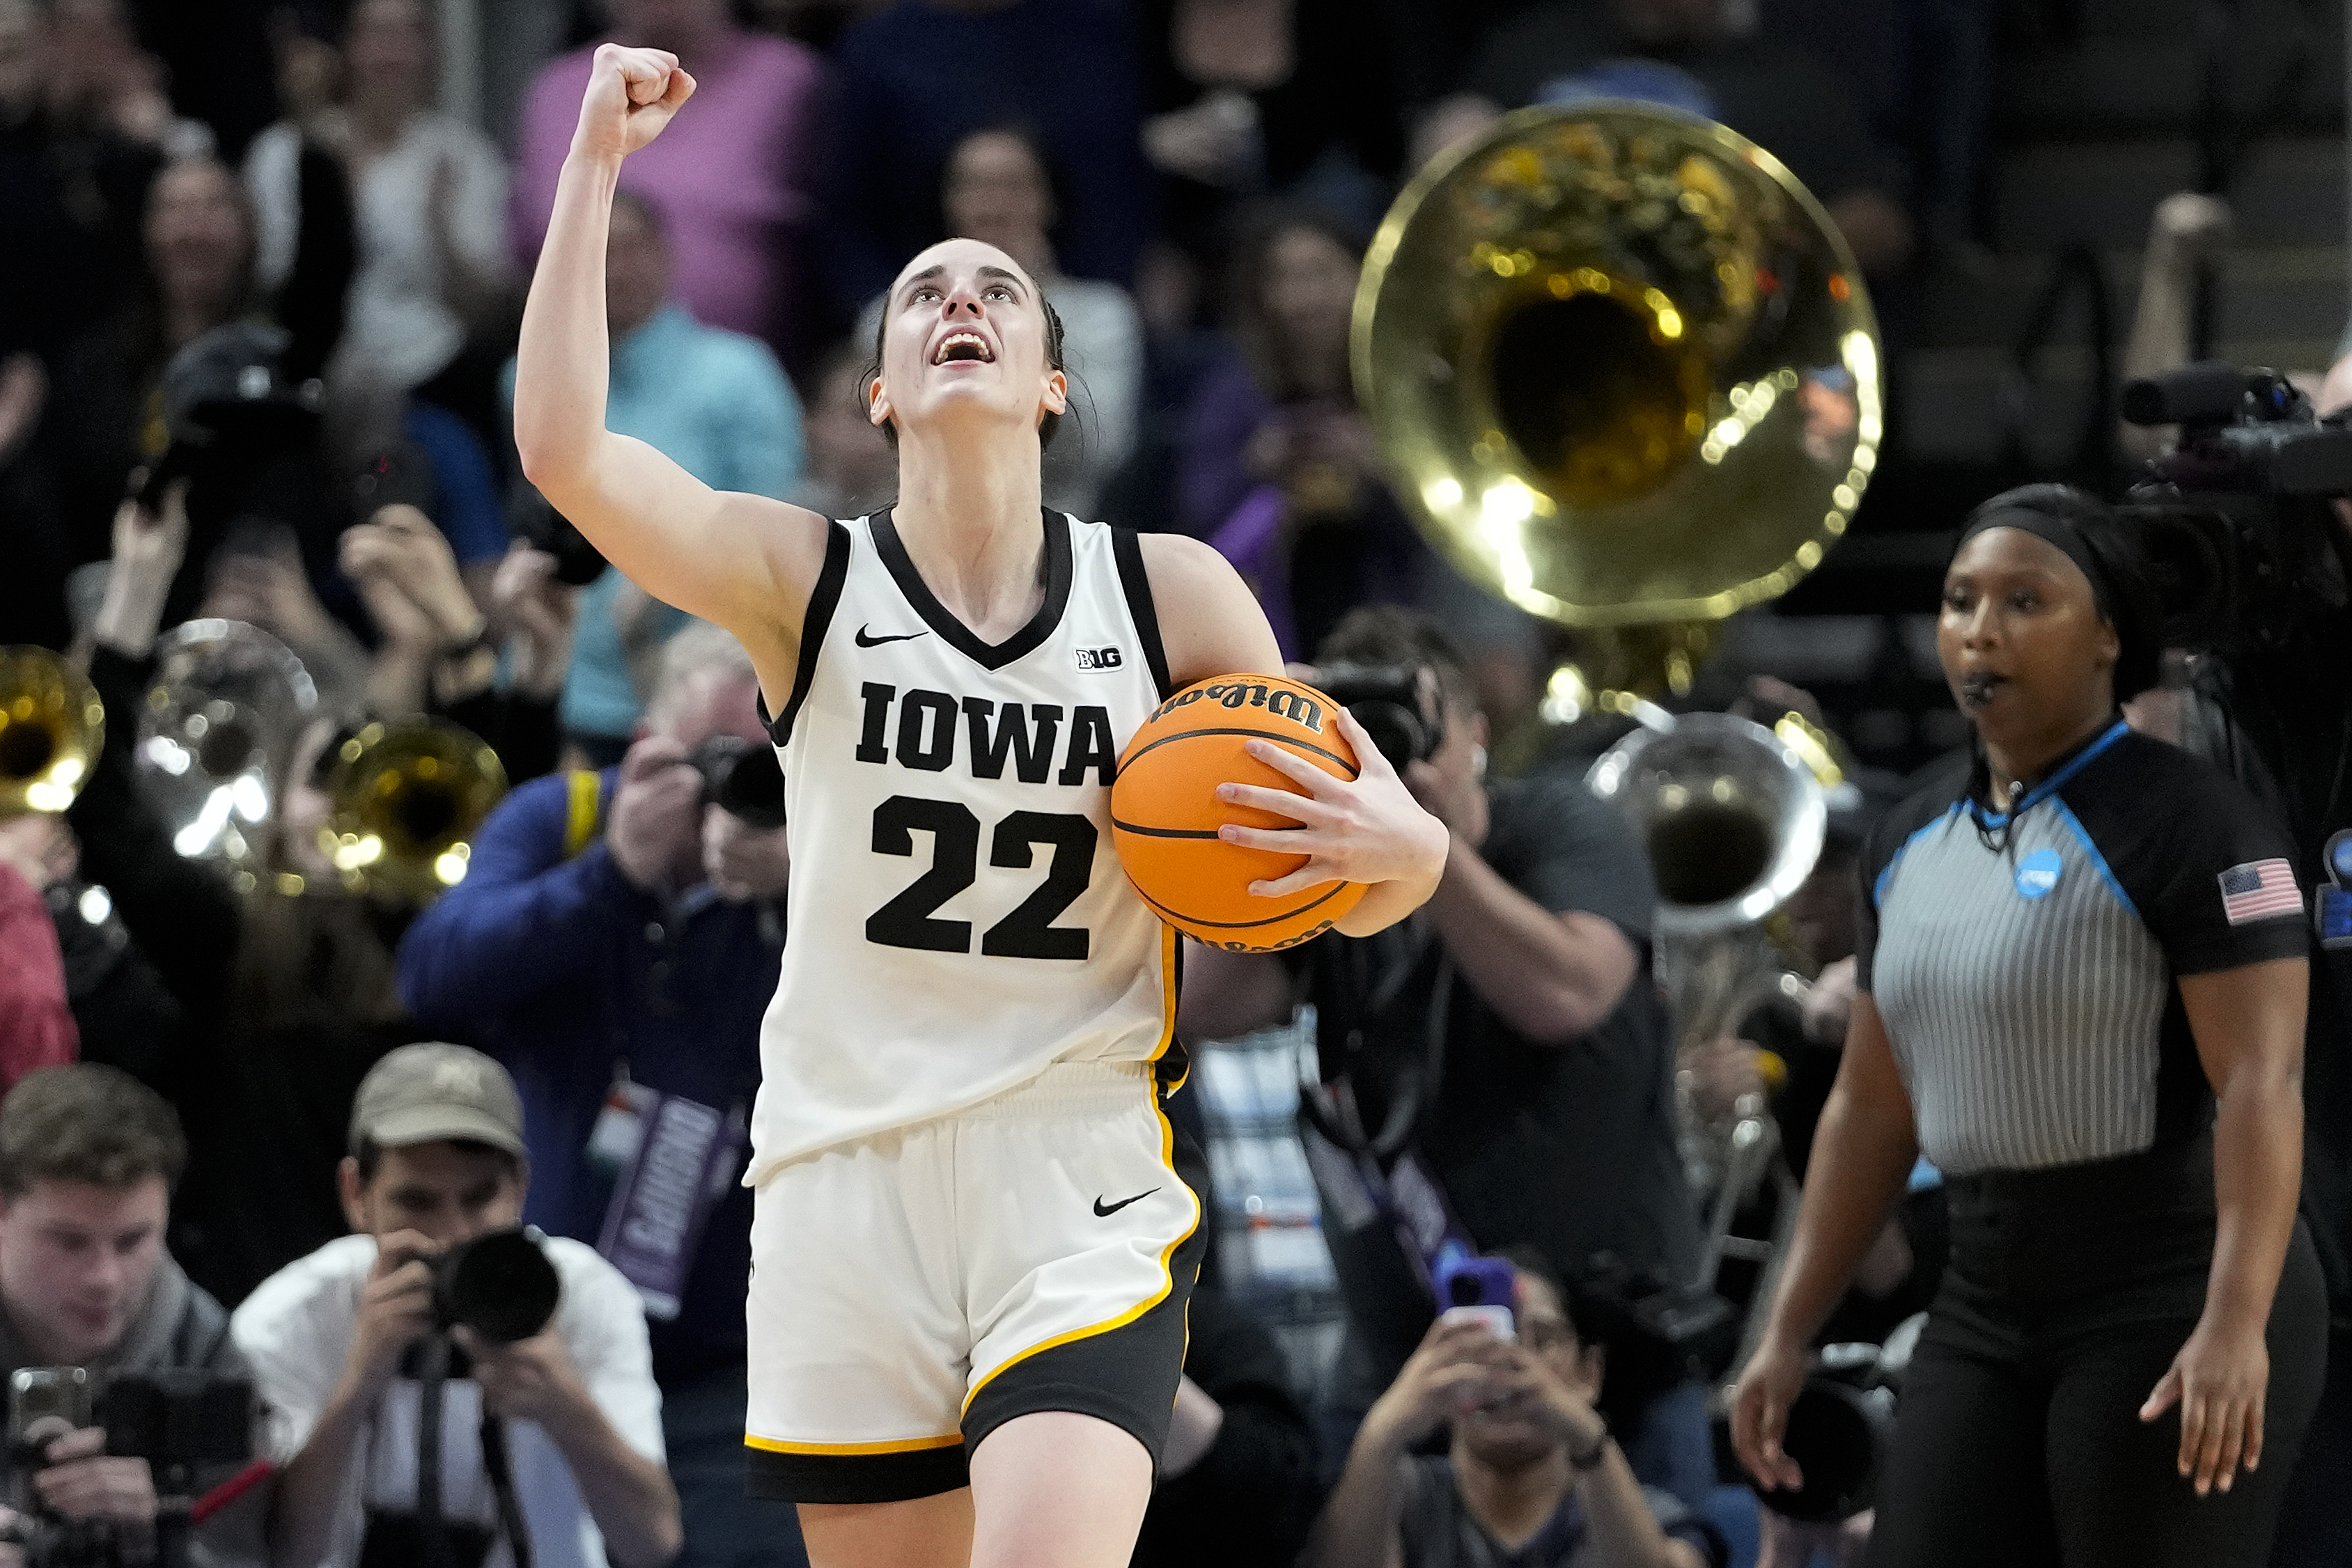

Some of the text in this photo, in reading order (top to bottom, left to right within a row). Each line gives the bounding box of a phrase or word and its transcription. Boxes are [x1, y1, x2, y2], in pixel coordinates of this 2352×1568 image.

[856, 681, 1116, 786] IOWA
[1150, 683, 1323, 735] Wilson
[866, 794, 1099, 960] 22
